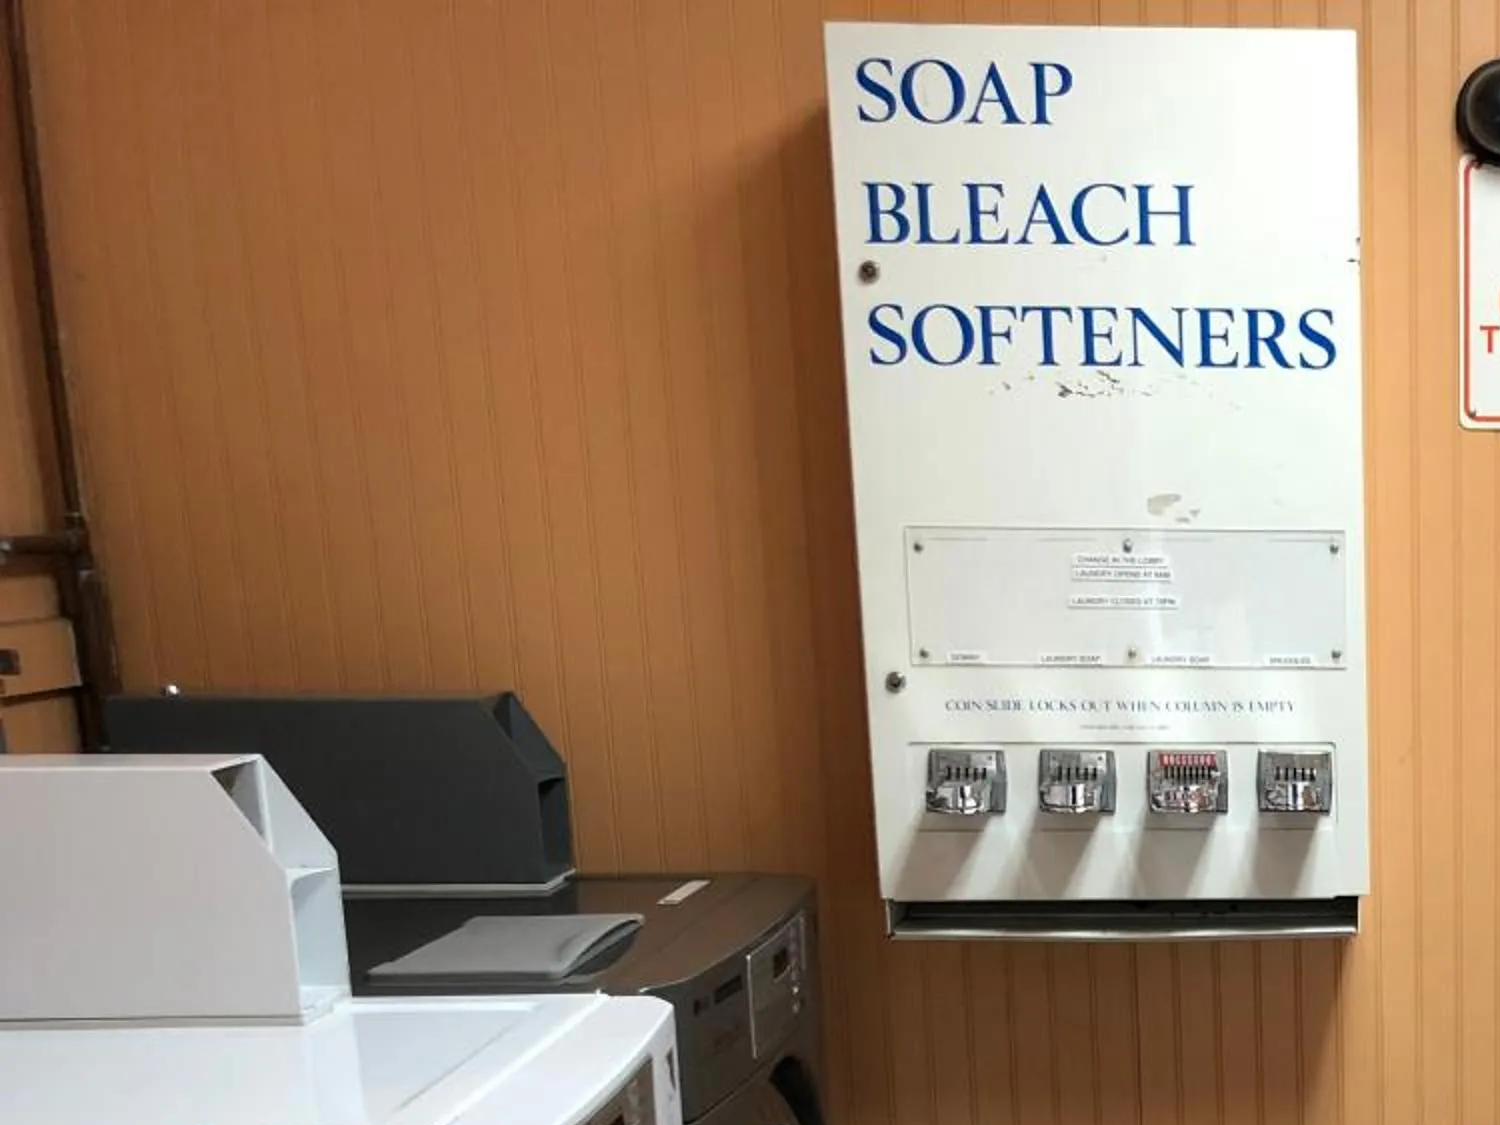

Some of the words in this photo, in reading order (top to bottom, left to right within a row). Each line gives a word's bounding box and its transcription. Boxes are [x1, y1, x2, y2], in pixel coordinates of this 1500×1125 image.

[856, 58, 1073, 125] SOAP
[862, 182, 1196, 246] BLEACH
[868, 303, 1337, 370] SOFTENERS
[945, 699, 982, 711] COIN
[985, 699, 1021, 711] SLIDE
[1029, 699, 1077, 711] LOCKS
[1081, 699, 1110, 711] OUT
[1116, 700, 1162, 712] WHEN
[1165, 700, 1229, 712] COLUMN
[1232, 701, 1244, 712] IS
[1249, 701, 1295, 712] EMPTY
